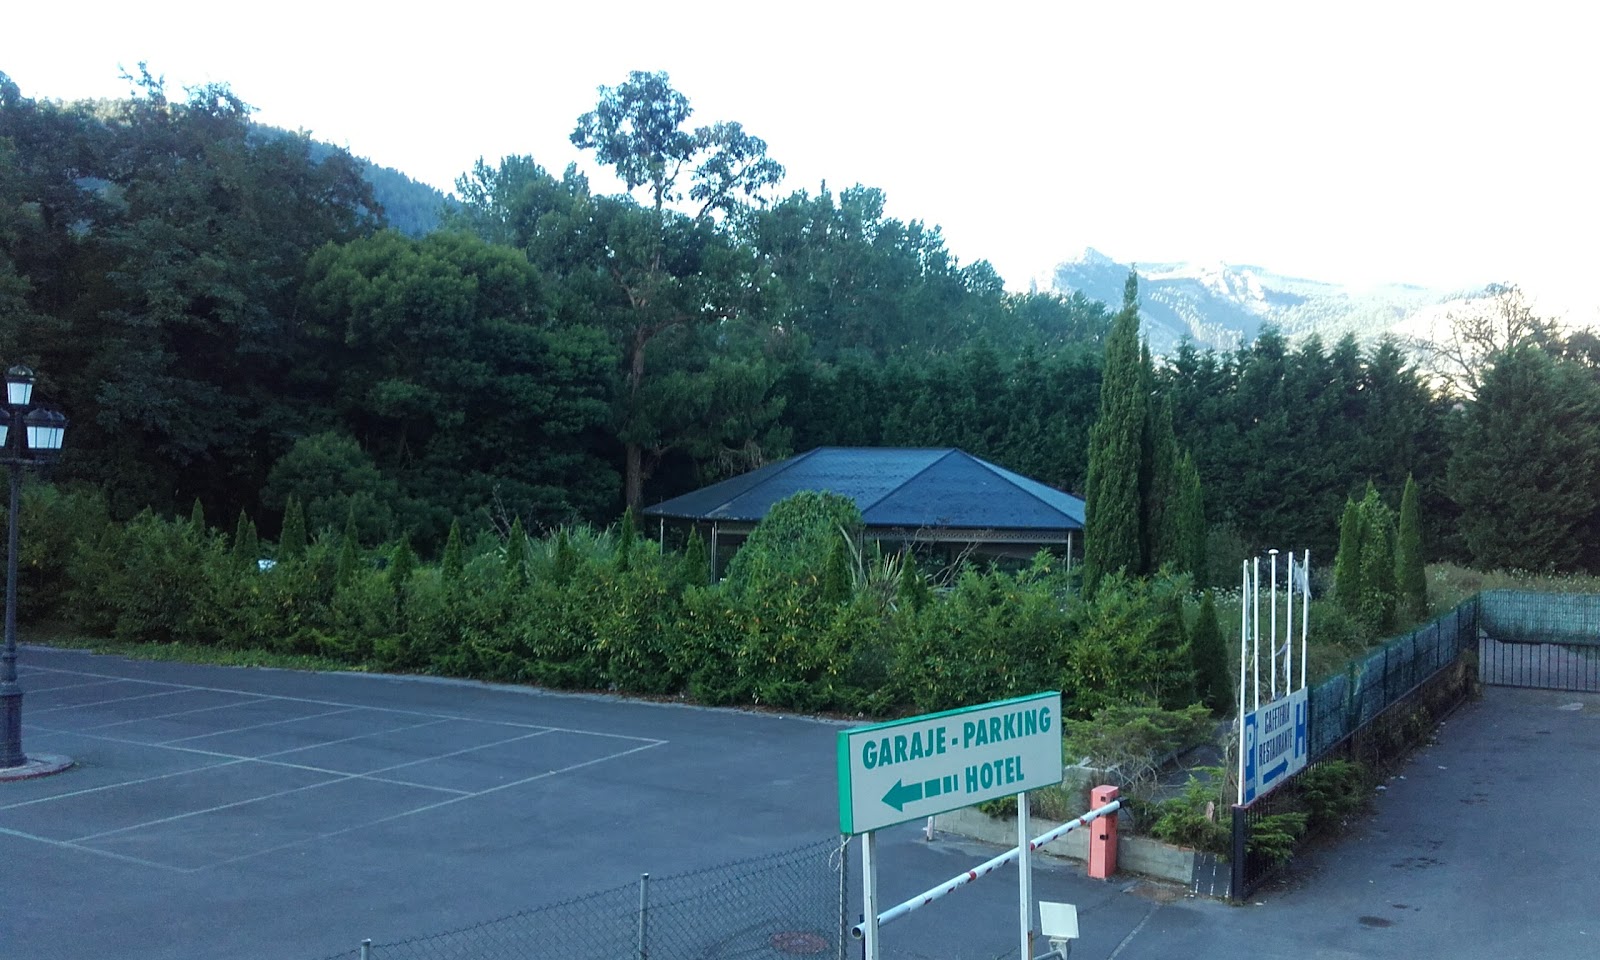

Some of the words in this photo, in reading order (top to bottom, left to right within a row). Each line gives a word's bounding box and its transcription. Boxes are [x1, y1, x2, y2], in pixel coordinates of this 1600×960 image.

[862, 727, 946, 770] GARAJE
[964, 706, 1051, 749] PARKING
[1246, 723, 1254, 767] P
[1259, 728, 1292, 767] RESTAURANTE
[1295, 700, 1306, 759] H
[966, 756, 1024, 794] HOTEL
